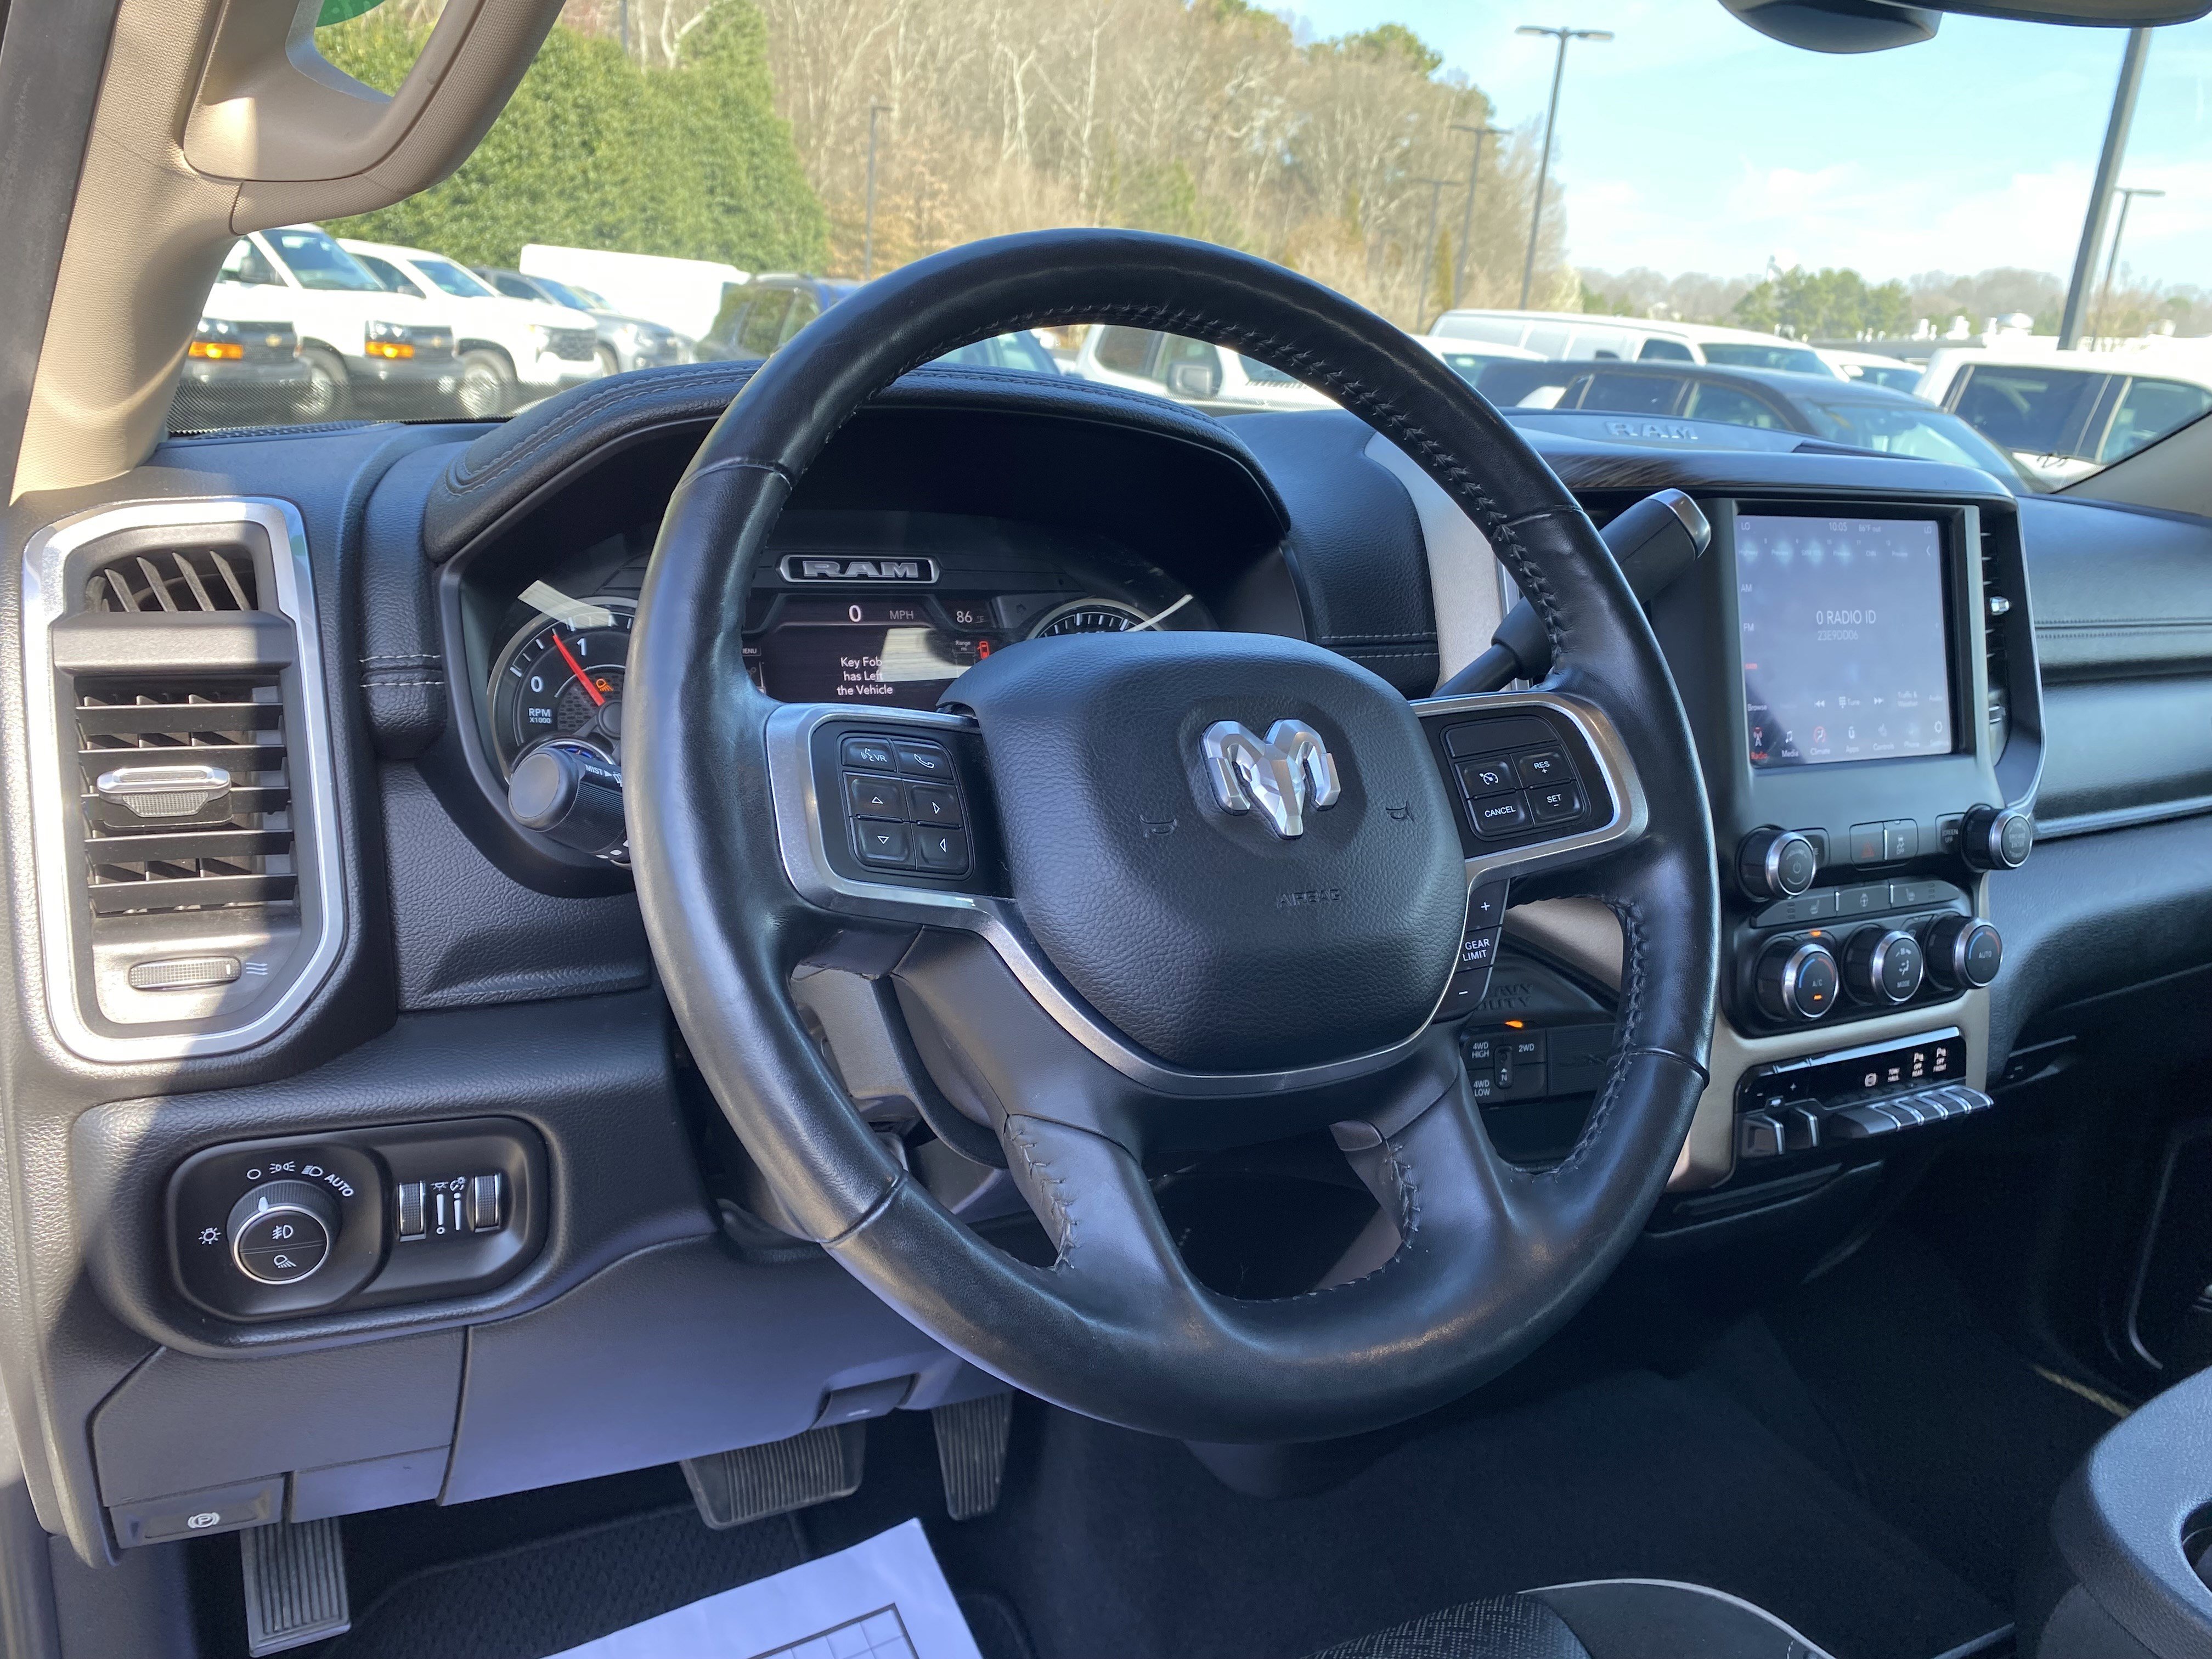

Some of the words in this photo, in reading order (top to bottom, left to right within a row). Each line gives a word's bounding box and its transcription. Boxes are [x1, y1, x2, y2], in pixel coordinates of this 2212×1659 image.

[1605, 421, 1699, 440] RAM
[1741, 522, 1750, 531] LO
[1829, 522, 1847, 532] 10:05
[802, 561, 919, 578] RAM
[1741, 584, 1752, 592] AM
[849, 605, 862, 622] 0
[889, 610, 915, 620] MPH
[956, 611, 973, 623] 86
[1816, 610, 1823, 625] 0
[1826, 610, 1861, 624] RADIO
[1865, 609, 1876, 624] ID
[1743, 623, 1754, 631] FM
[577, 637, 588, 656] 1
[840, 657, 860, 669] Key
[863, 656, 882, 667] Fob
[843, 671, 861, 681] has
[864, 670, 883, 681] Left
[531, 675, 543, 693] 0
[837, 685, 854, 696] the
[856, 685, 893, 696] Vehicle
[528, 707, 551, 717] RPM
[1747, 703, 1768, 712] Browse
[873, 754, 887, 762] VR
[1750, 752, 1768, 760] Radio
[585, 764, 603, 776] MIST
[1533, 760, 1550, 770] RES
[1546, 794, 1562, 804] SET
[1485, 805, 1516, 818] CANCEL
[1277, 888, 1342, 909] AIRBAG
[1465, 938, 1490, 951] GEAR
[1462, 949, 1487, 962] LIMIT
[1978, 951, 1993, 960] AUTO
[1812, 978, 1822, 987] A/C
[1473, 1042, 1489, 1050] 4WD
[1519, 1043, 1534, 1052] 2WD
[1472, 1049, 1489, 1059] HIGH
[1474, 1080, 1489, 1088] 4WD
[1474, 1088, 1490, 1097] LOW
[324, 1173, 354, 1197] AUTO
